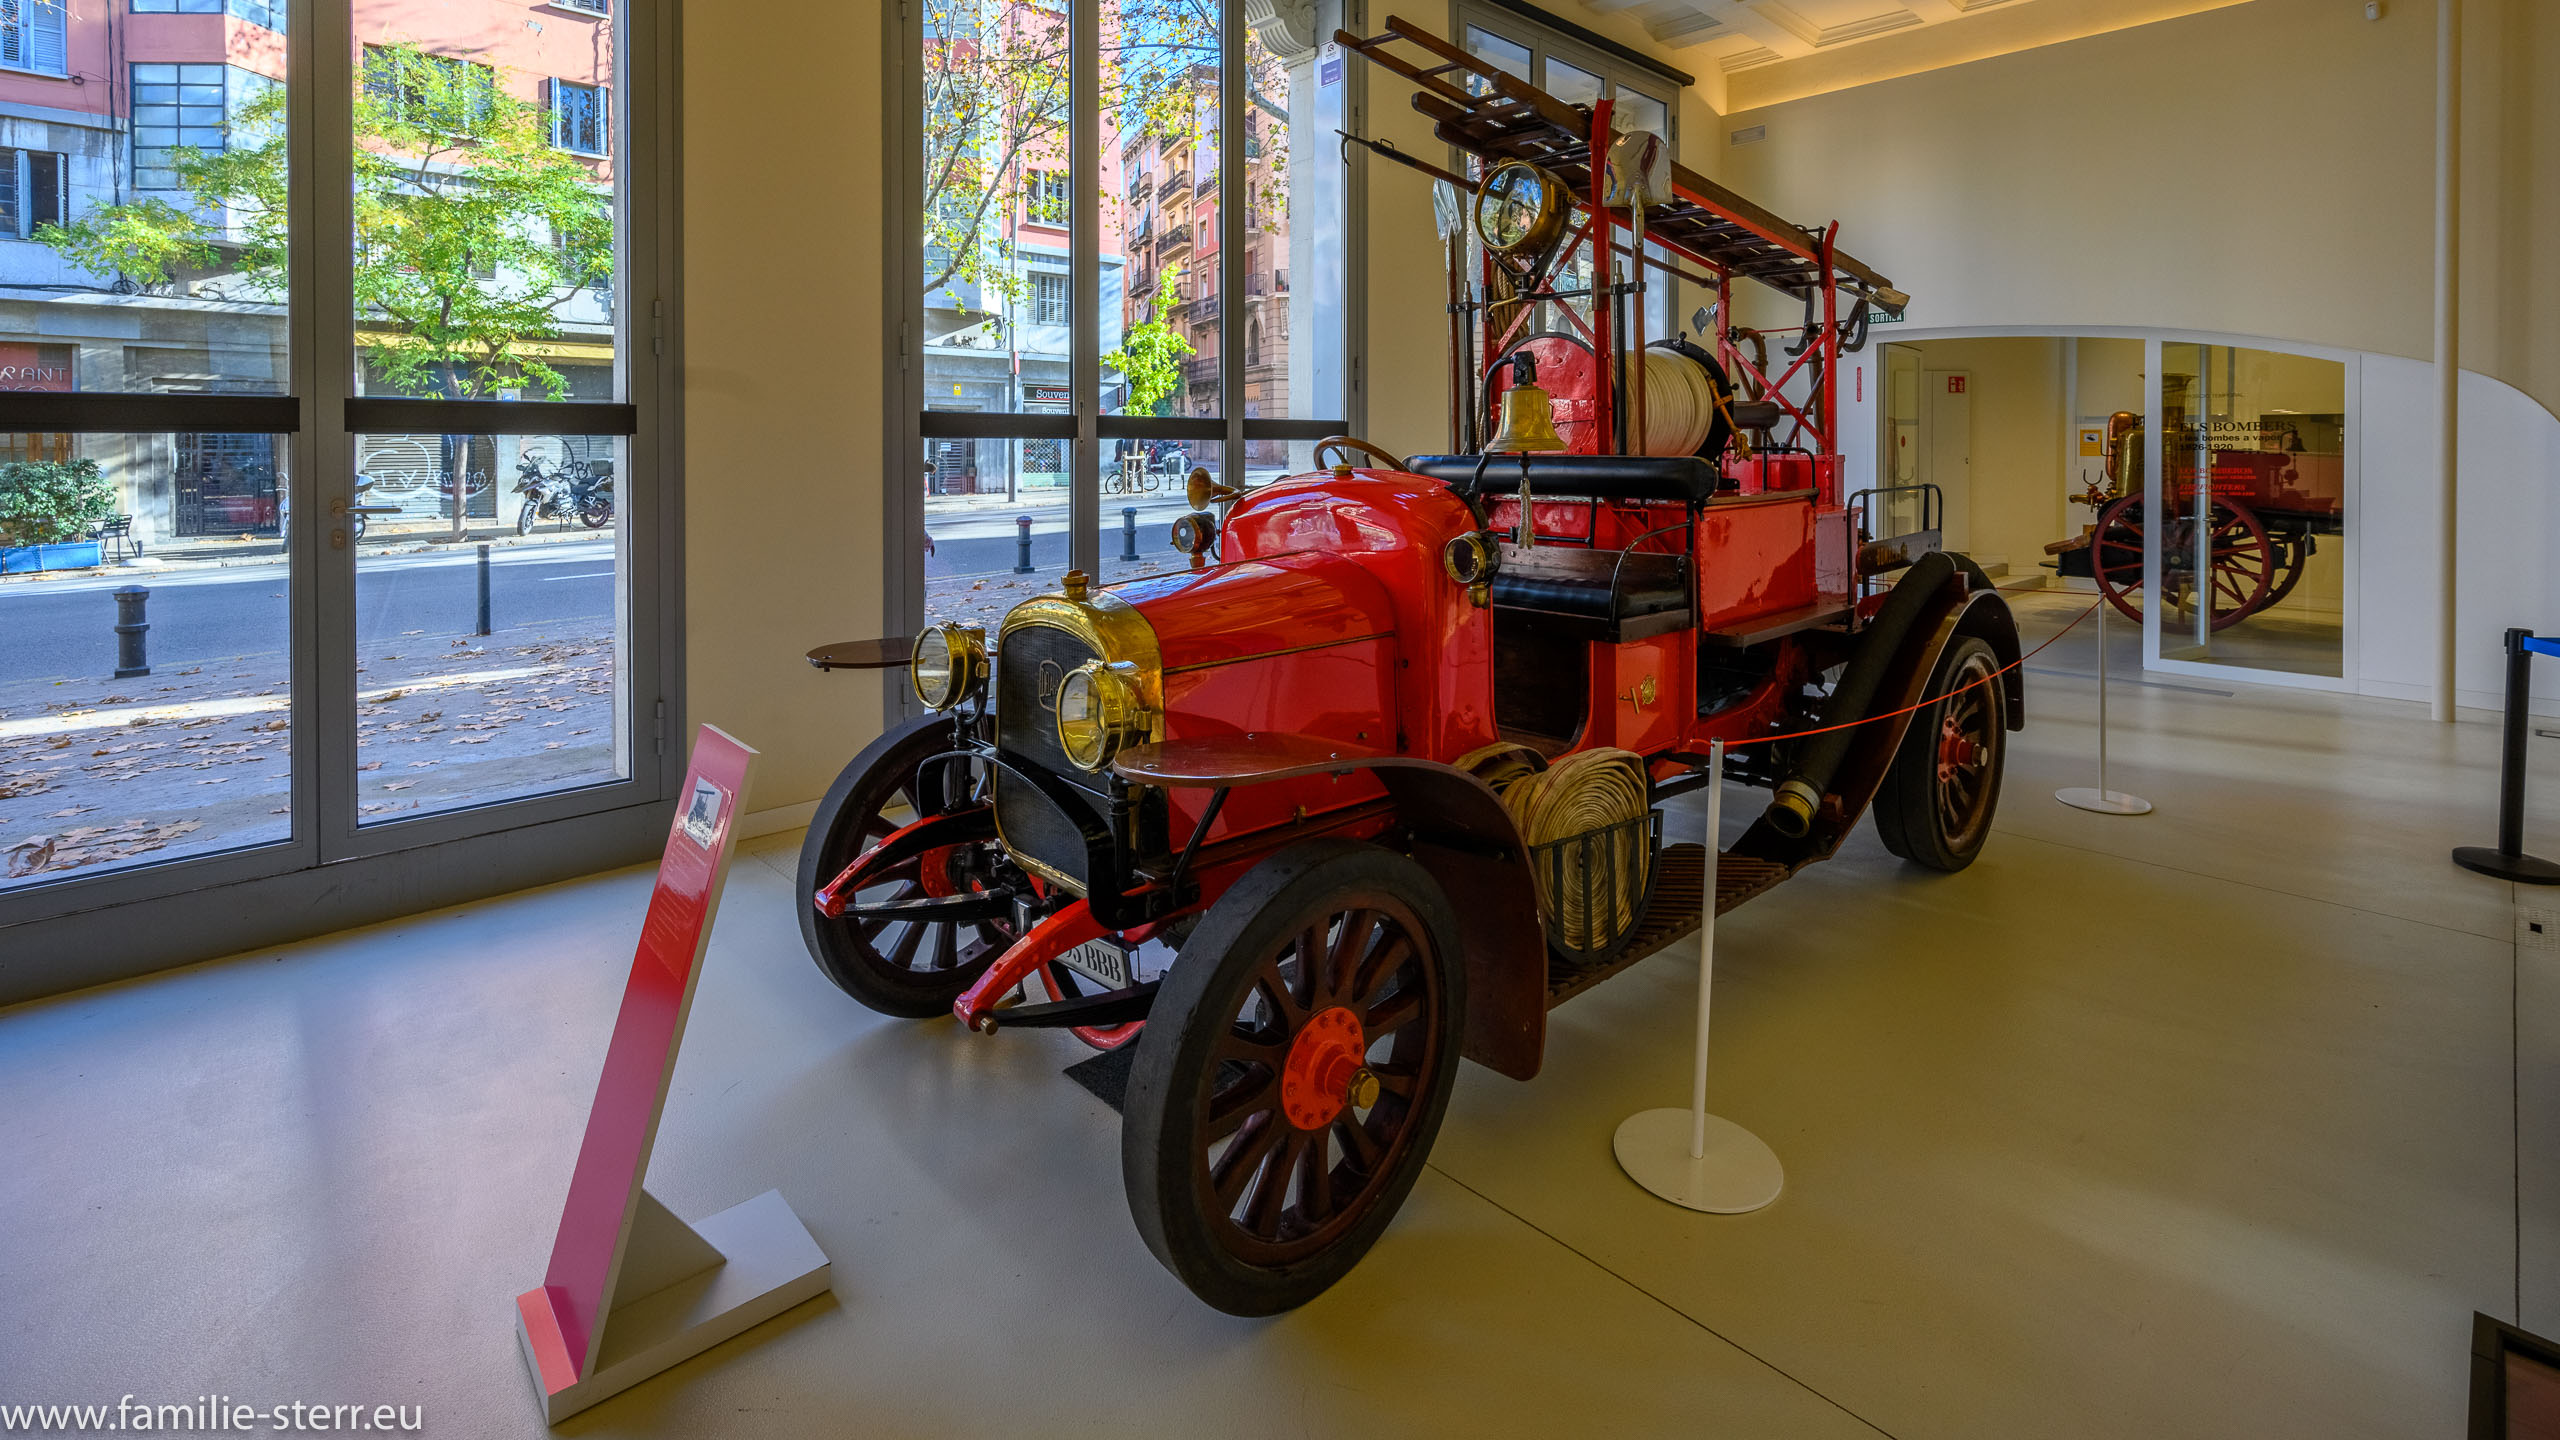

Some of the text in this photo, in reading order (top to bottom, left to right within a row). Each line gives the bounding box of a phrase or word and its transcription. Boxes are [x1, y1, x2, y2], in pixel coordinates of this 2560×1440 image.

[2179, 421, 2296, 433] ELS BOMBERS
[2202, 434, 2240, 442] bombes
[1084, 943, 1121, 982] BBB
